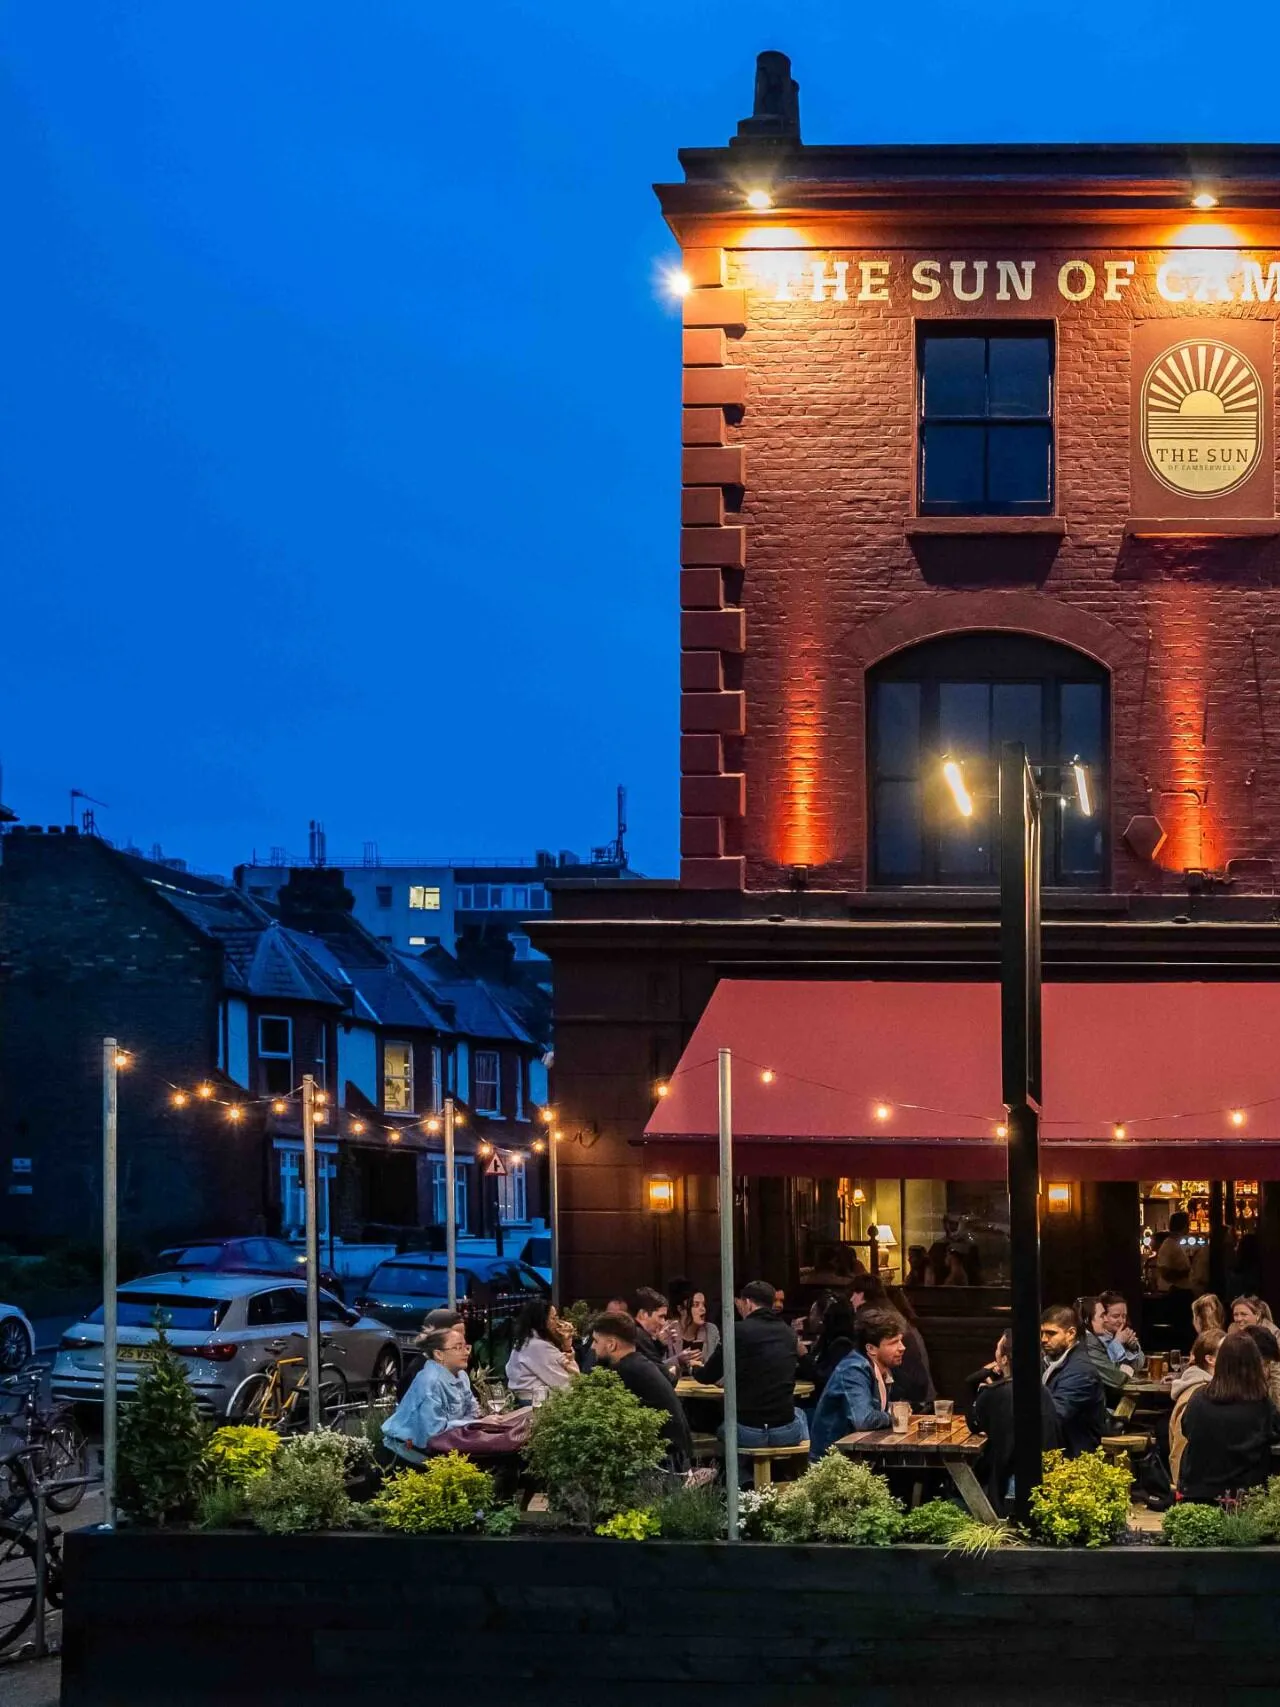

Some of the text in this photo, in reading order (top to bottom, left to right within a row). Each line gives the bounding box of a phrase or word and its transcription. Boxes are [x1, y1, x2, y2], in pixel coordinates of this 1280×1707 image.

[911, 260, 1036, 301] SUN
[1057, 260, 1135, 302] OF
[1156, 448, 1249, 463] THE SUN
